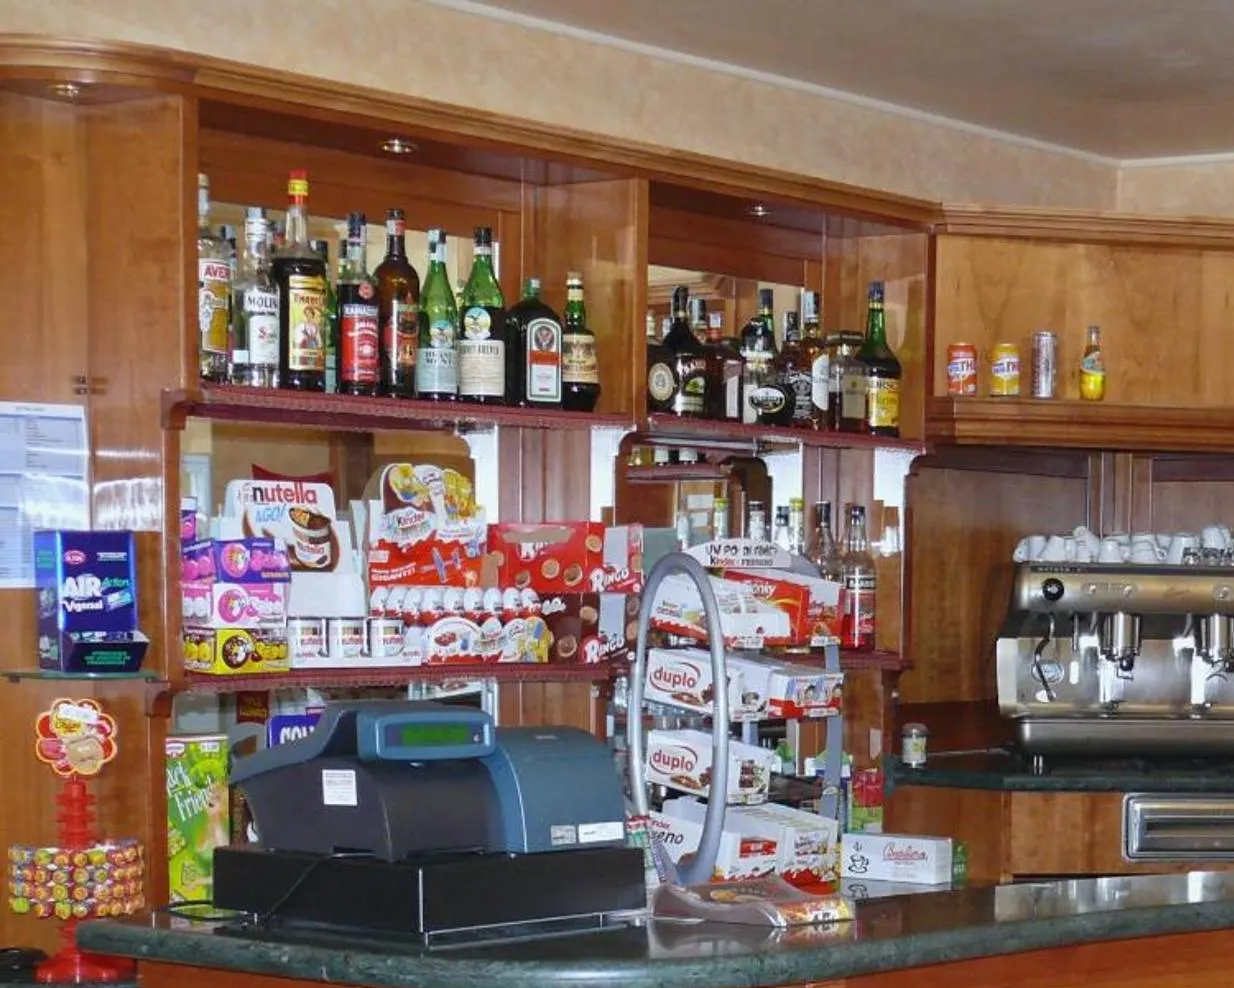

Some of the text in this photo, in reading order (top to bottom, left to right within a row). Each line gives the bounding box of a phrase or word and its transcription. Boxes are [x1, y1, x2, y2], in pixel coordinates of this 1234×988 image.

[253, 483, 318, 505] nutella
[63, 574, 102, 598] AIR
[590, 566, 630, 593] RINGO
[584, 636, 625, 664] RINGO
[653, 665, 697, 689] duplo
[652, 749, 694, 772] duplo
